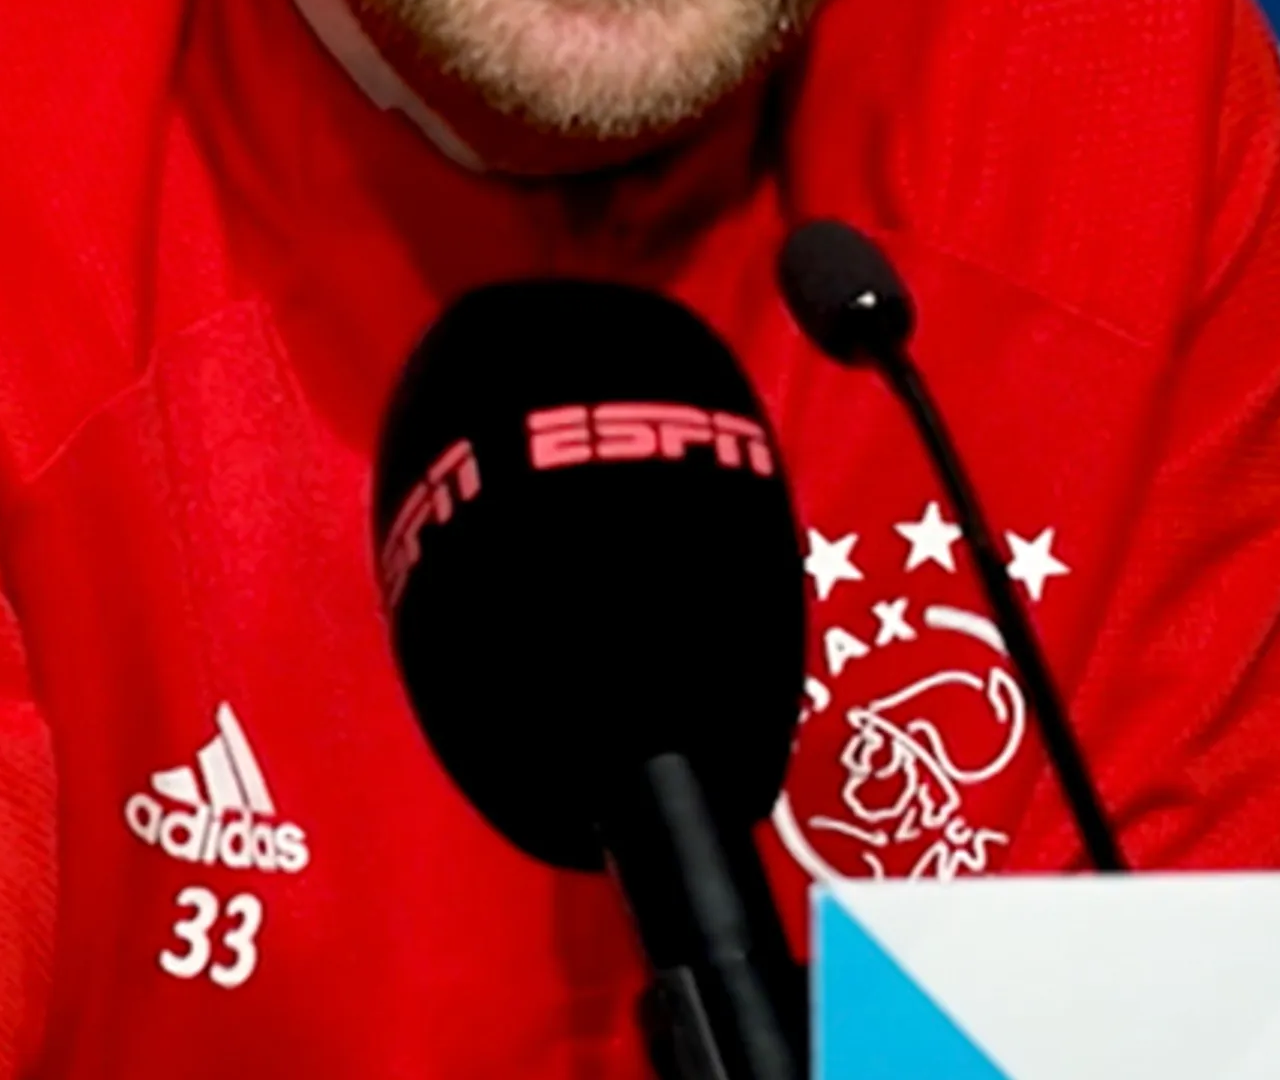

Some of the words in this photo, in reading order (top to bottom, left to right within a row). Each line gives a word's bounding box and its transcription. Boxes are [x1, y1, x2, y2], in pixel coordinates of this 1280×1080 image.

[526, 400, 774, 477] ESPN
[124, 792, 311, 874] adidas
[158, 885, 264, 990] 33
